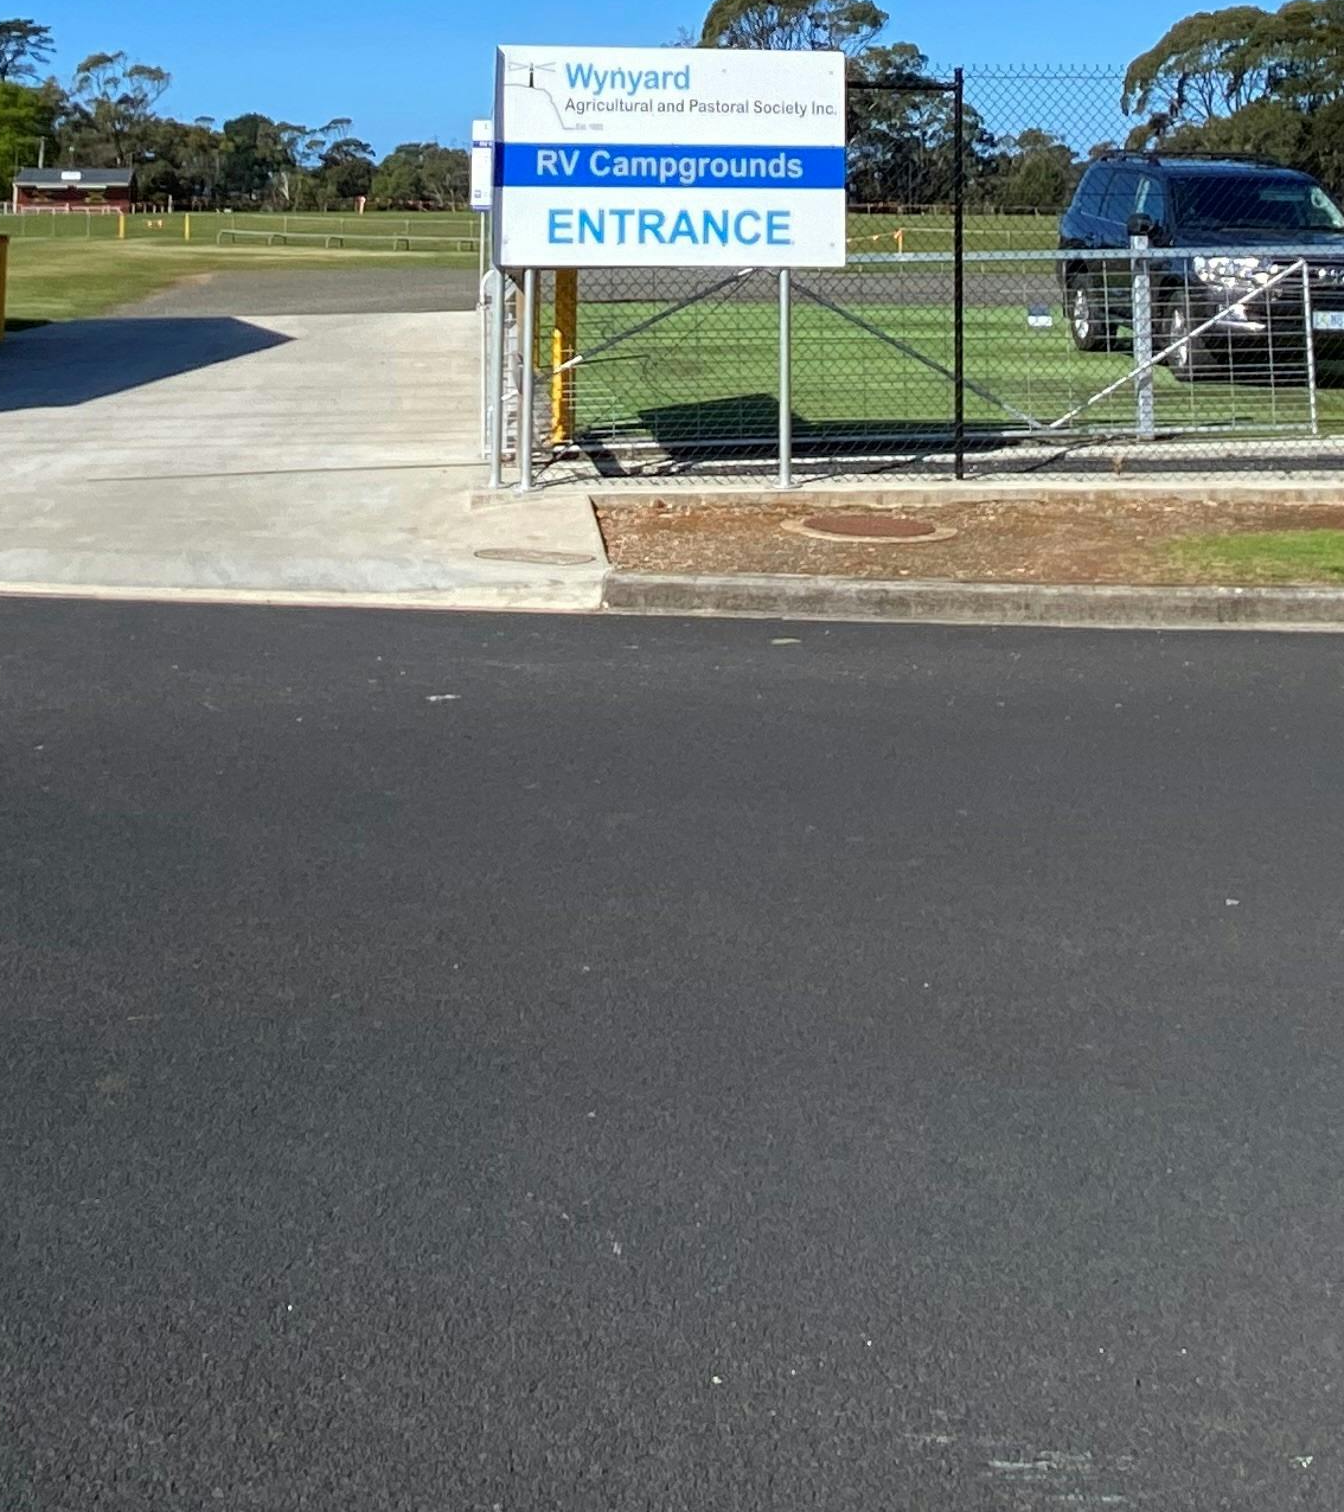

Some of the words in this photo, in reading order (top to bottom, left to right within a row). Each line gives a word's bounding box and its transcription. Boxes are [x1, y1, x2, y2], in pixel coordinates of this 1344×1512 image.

[564, 62, 691, 96] Wynyard
[564, 97, 654, 115] Agricultural
[657, 99, 685, 113] and
[689, 99, 750, 114] Pastoral
[753, 100, 808, 119] Society
[811, 101, 838, 116] Inc.
[536, 149, 581, 177] RV
[589, 149, 804, 185] Campgrounds
[547, 208, 792, 246] ENTRANCE
